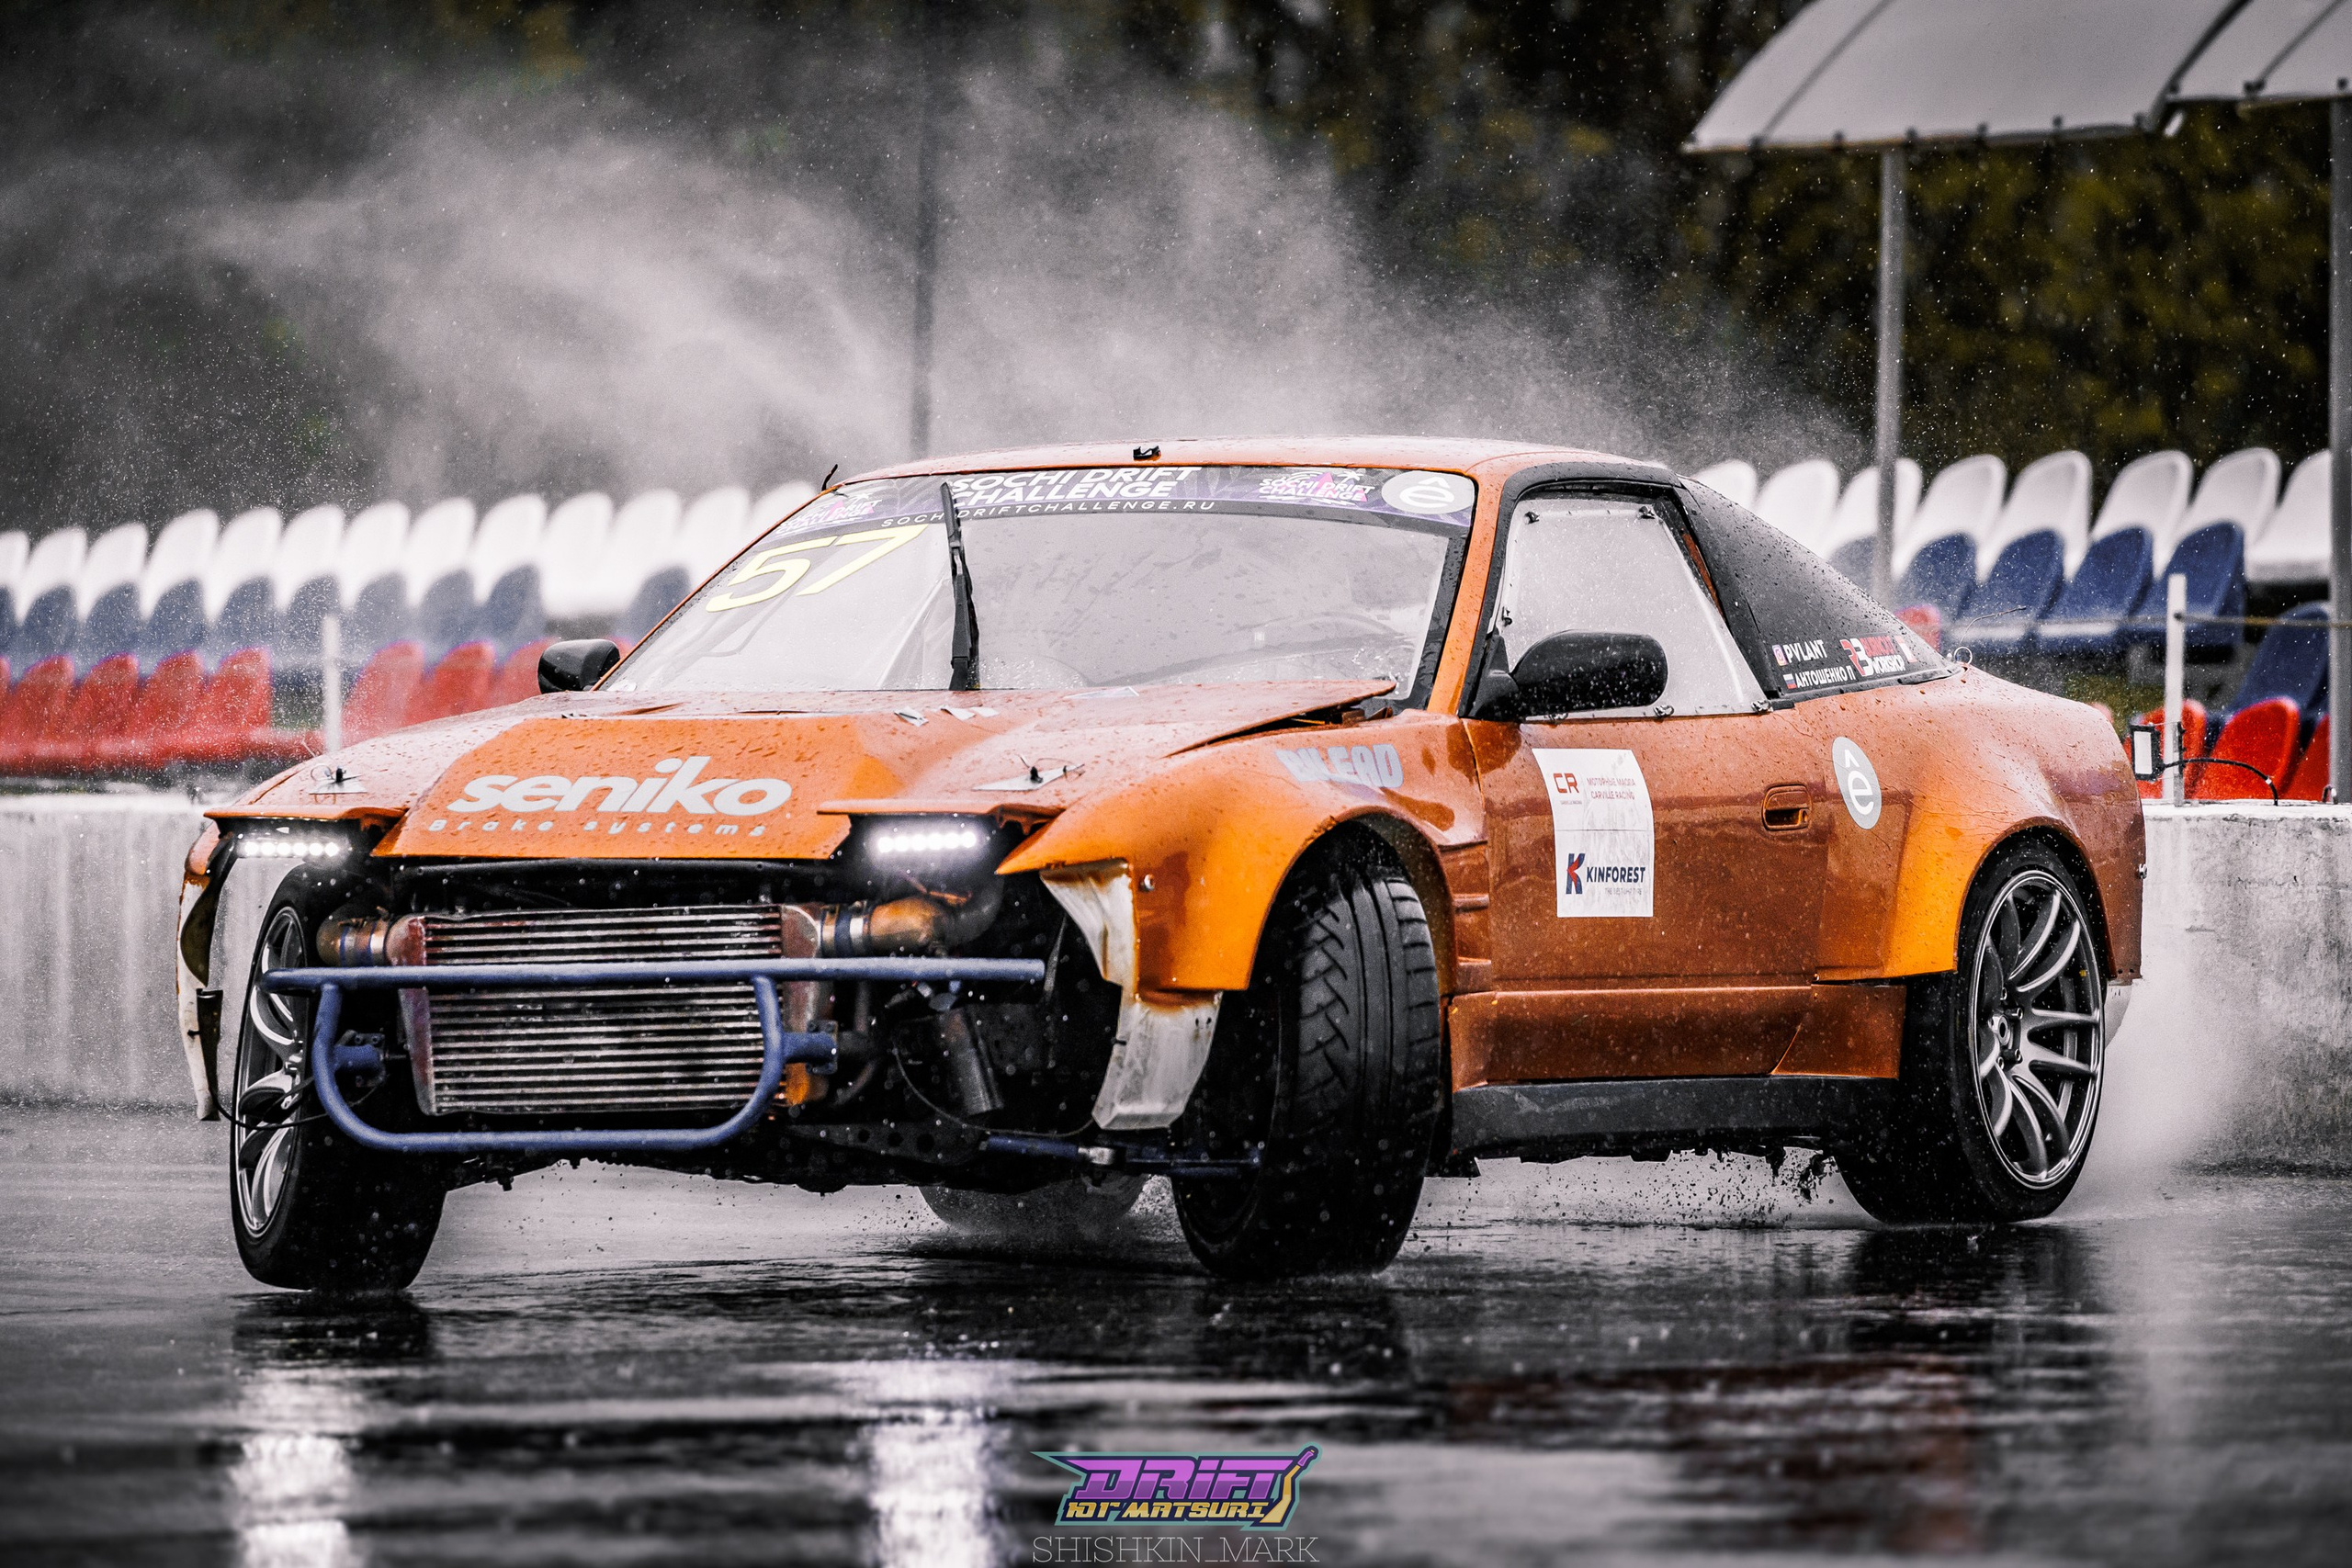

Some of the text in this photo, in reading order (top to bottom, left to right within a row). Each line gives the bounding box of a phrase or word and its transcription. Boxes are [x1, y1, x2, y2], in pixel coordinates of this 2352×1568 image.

[952, 467, 1201, 493] SOCHI DRIFT
[1259, 478, 1375, 494] SOCHI DRIFT
[953, 480, 1177, 507] CHALLENGE
[1259, 485, 1364, 502] CHALLENGE
[706, 524, 929, 613] 57
[1782, 639, 1827, 663] PVLANT
[1871, 654, 1906, 674] WORKSHOP
[1794, 667, 1848, 689] АНТОШЕНКО
[447, 756, 793, 817] seniko
[1553, 773, 1580, 794] CR
[1590, 790, 1635, 800] CARVILLE RACING
[428, 819, 767, 838] Brake systems
[1586, 866, 1646, 883] KINFOREST
